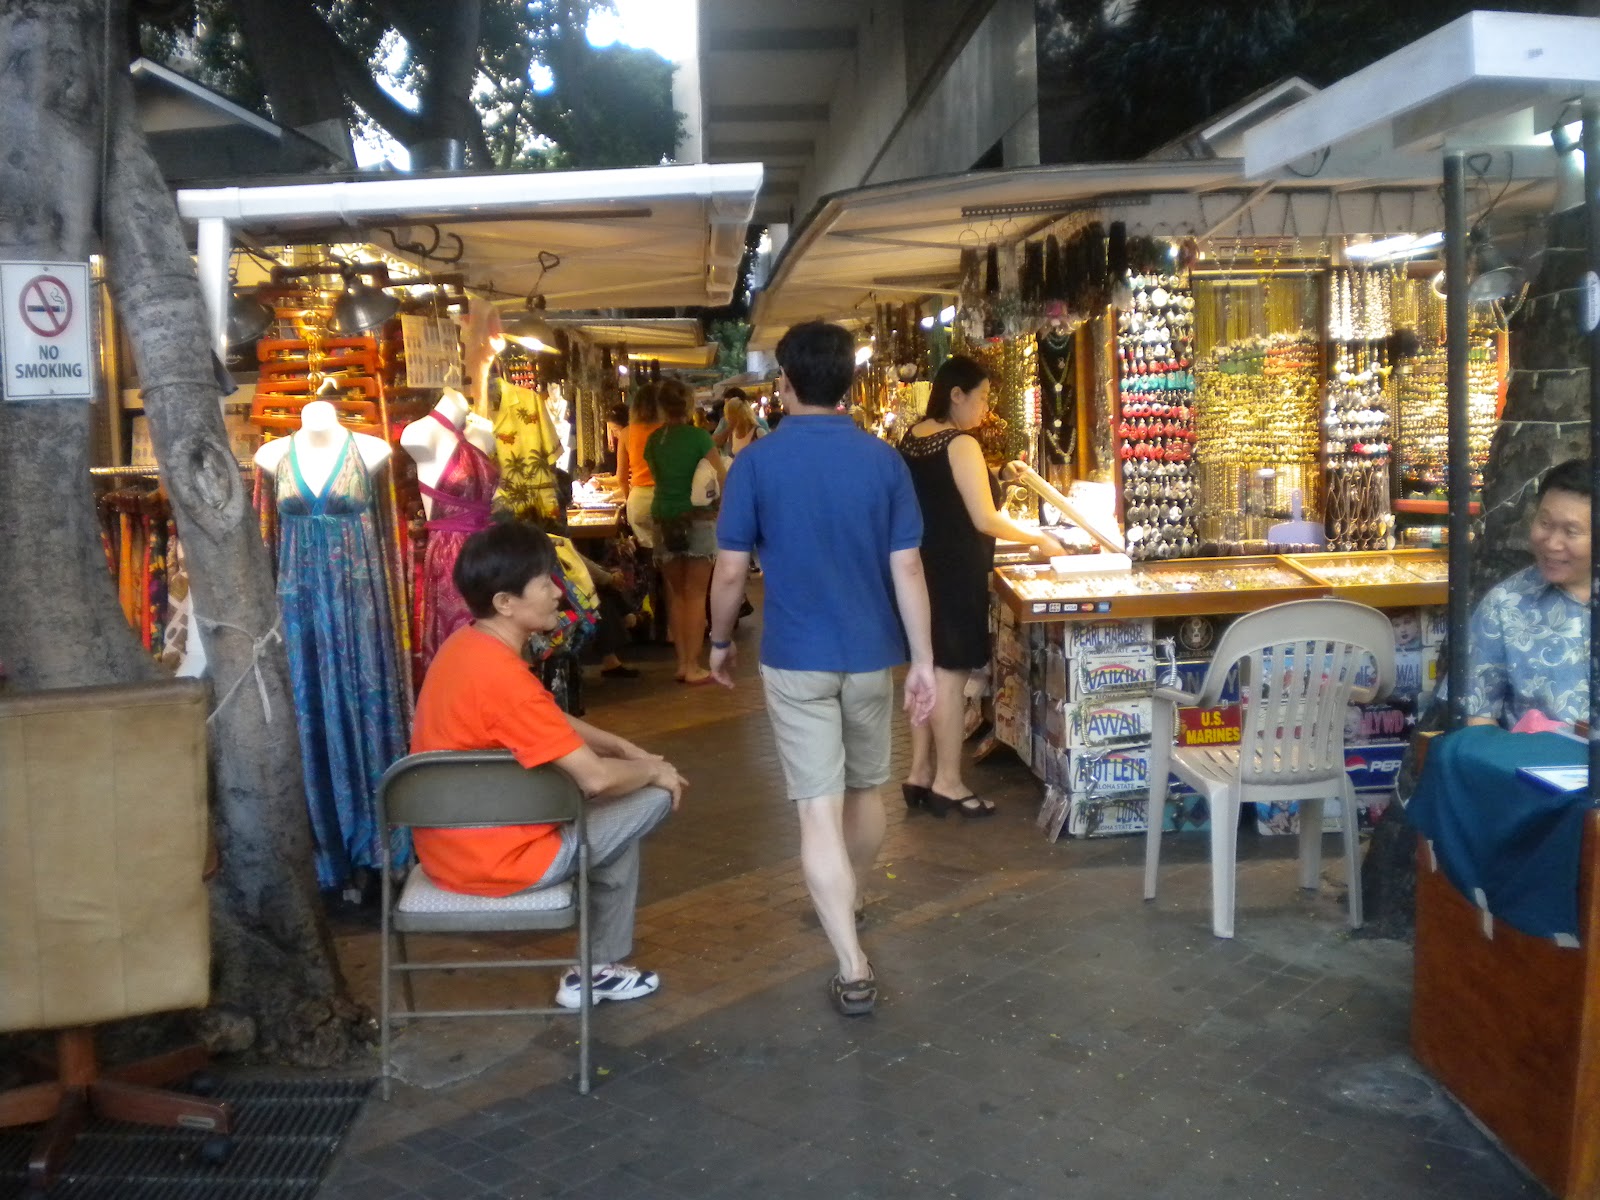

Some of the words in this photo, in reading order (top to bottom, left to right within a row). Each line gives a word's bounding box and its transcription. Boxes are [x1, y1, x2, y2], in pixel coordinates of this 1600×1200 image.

[39, 345, 59, 360] NO
[15, 363, 82, 379] SMOKING
[1074, 624, 1103, 647] PEARL
[1104, 622, 1143, 644] HARBOR
[1086, 668, 1147, 690] WAIKIKI
[1186, 669, 1238, 694] NY
[1201, 711, 1225, 726] U.S.
[1186, 727, 1241, 744] MARINES
[1370, 760, 1402, 773] PEP
